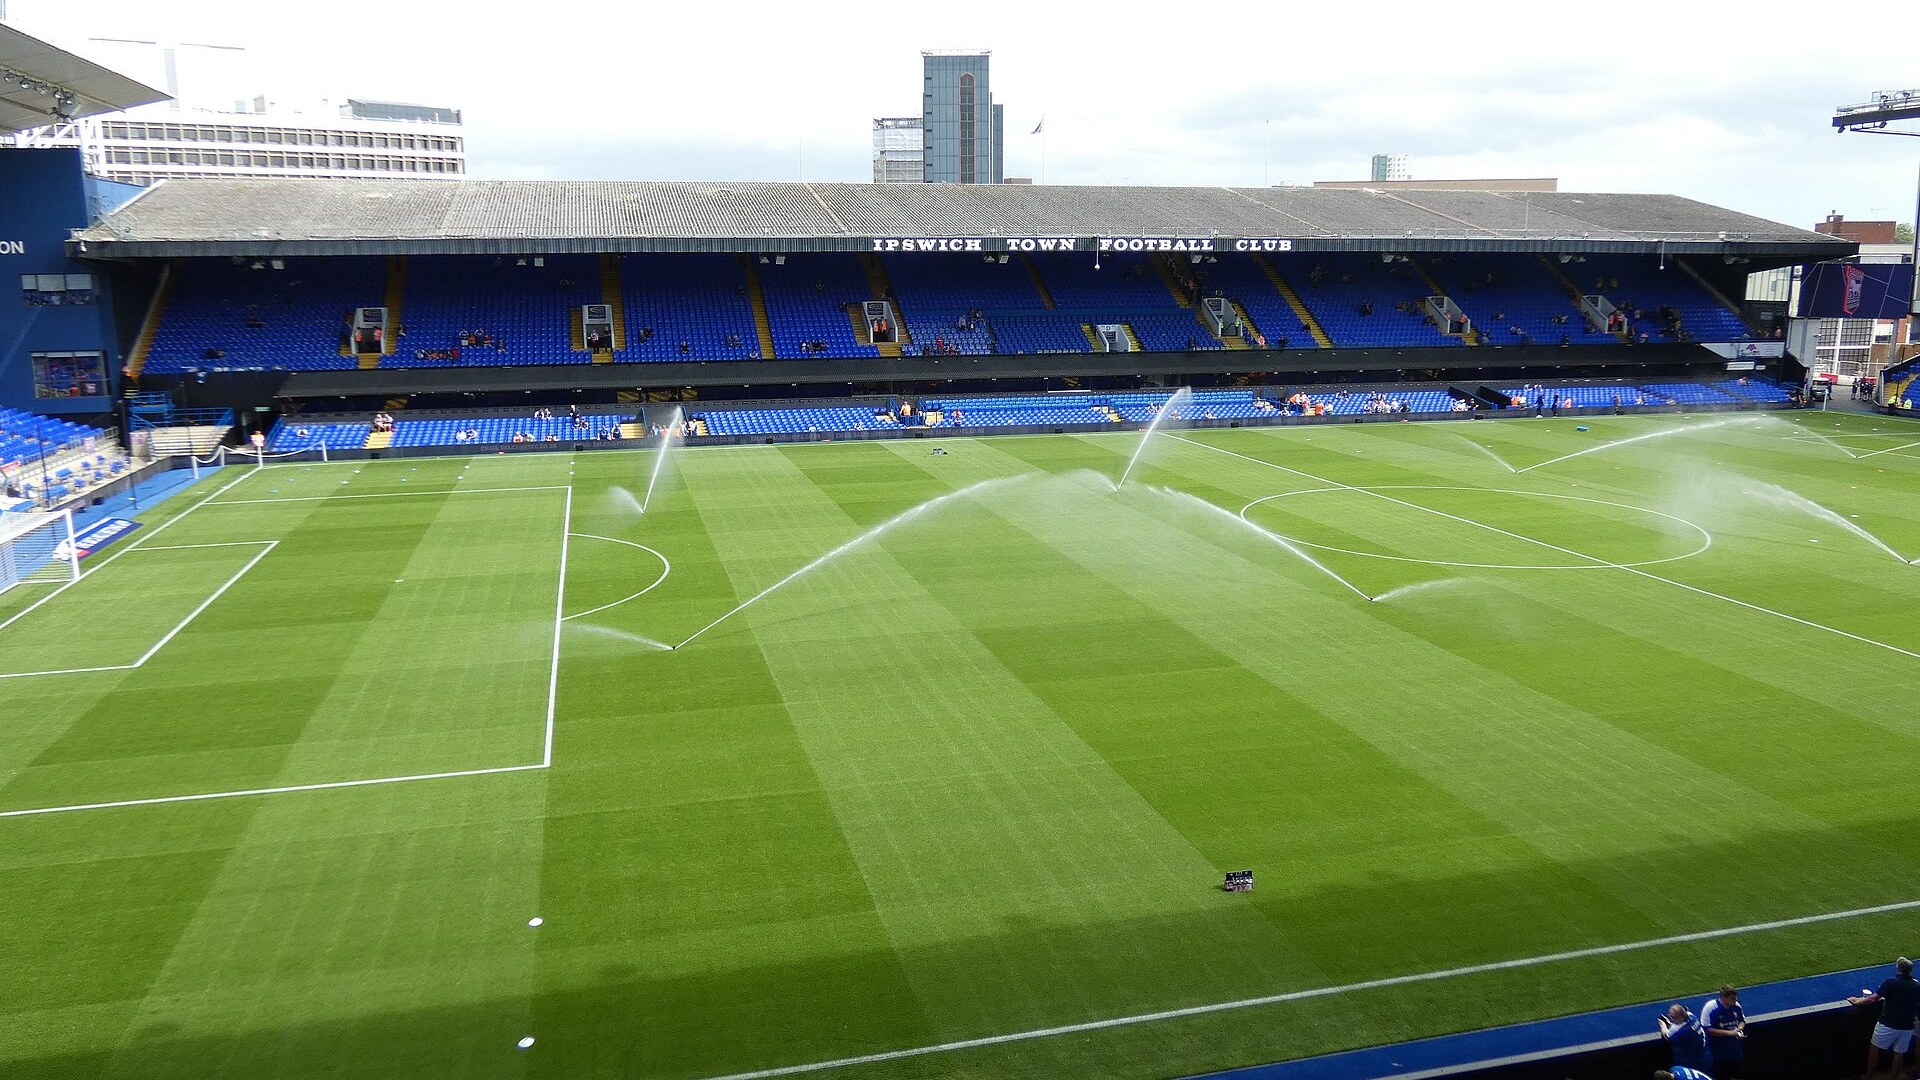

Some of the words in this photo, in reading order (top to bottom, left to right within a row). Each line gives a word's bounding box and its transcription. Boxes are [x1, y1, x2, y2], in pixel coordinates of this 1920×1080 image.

[0, 241, 24, 254] ON
[873, 238, 982, 251] IPSWICH
[1006, 238, 1076, 251] TOWN
[1099, 238, 1214, 251] FOOTBALL
[1235, 239, 1292, 251] CLUB
